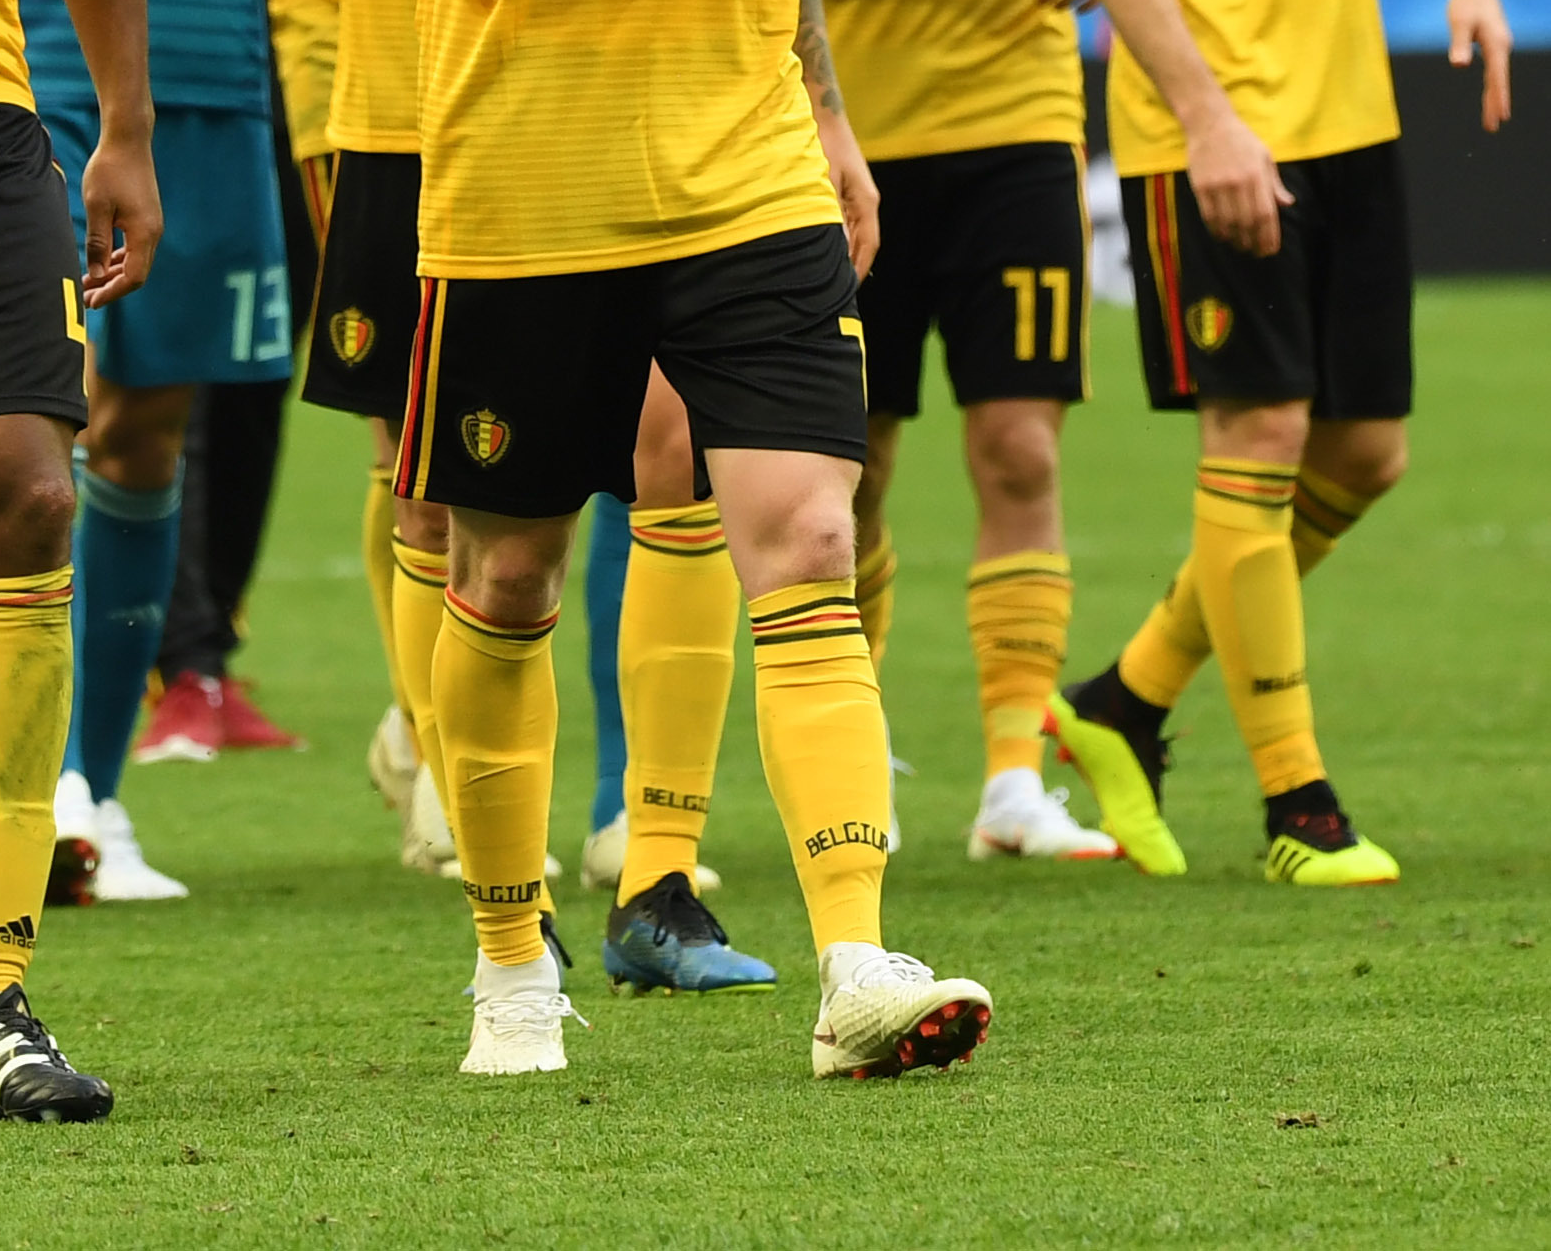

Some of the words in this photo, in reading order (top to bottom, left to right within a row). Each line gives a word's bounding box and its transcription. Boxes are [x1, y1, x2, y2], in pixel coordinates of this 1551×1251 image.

[224, 265, 293, 362] 13
[1001, 266, 1071, 363] 11
[642, 786, 711, 815] BELGI
